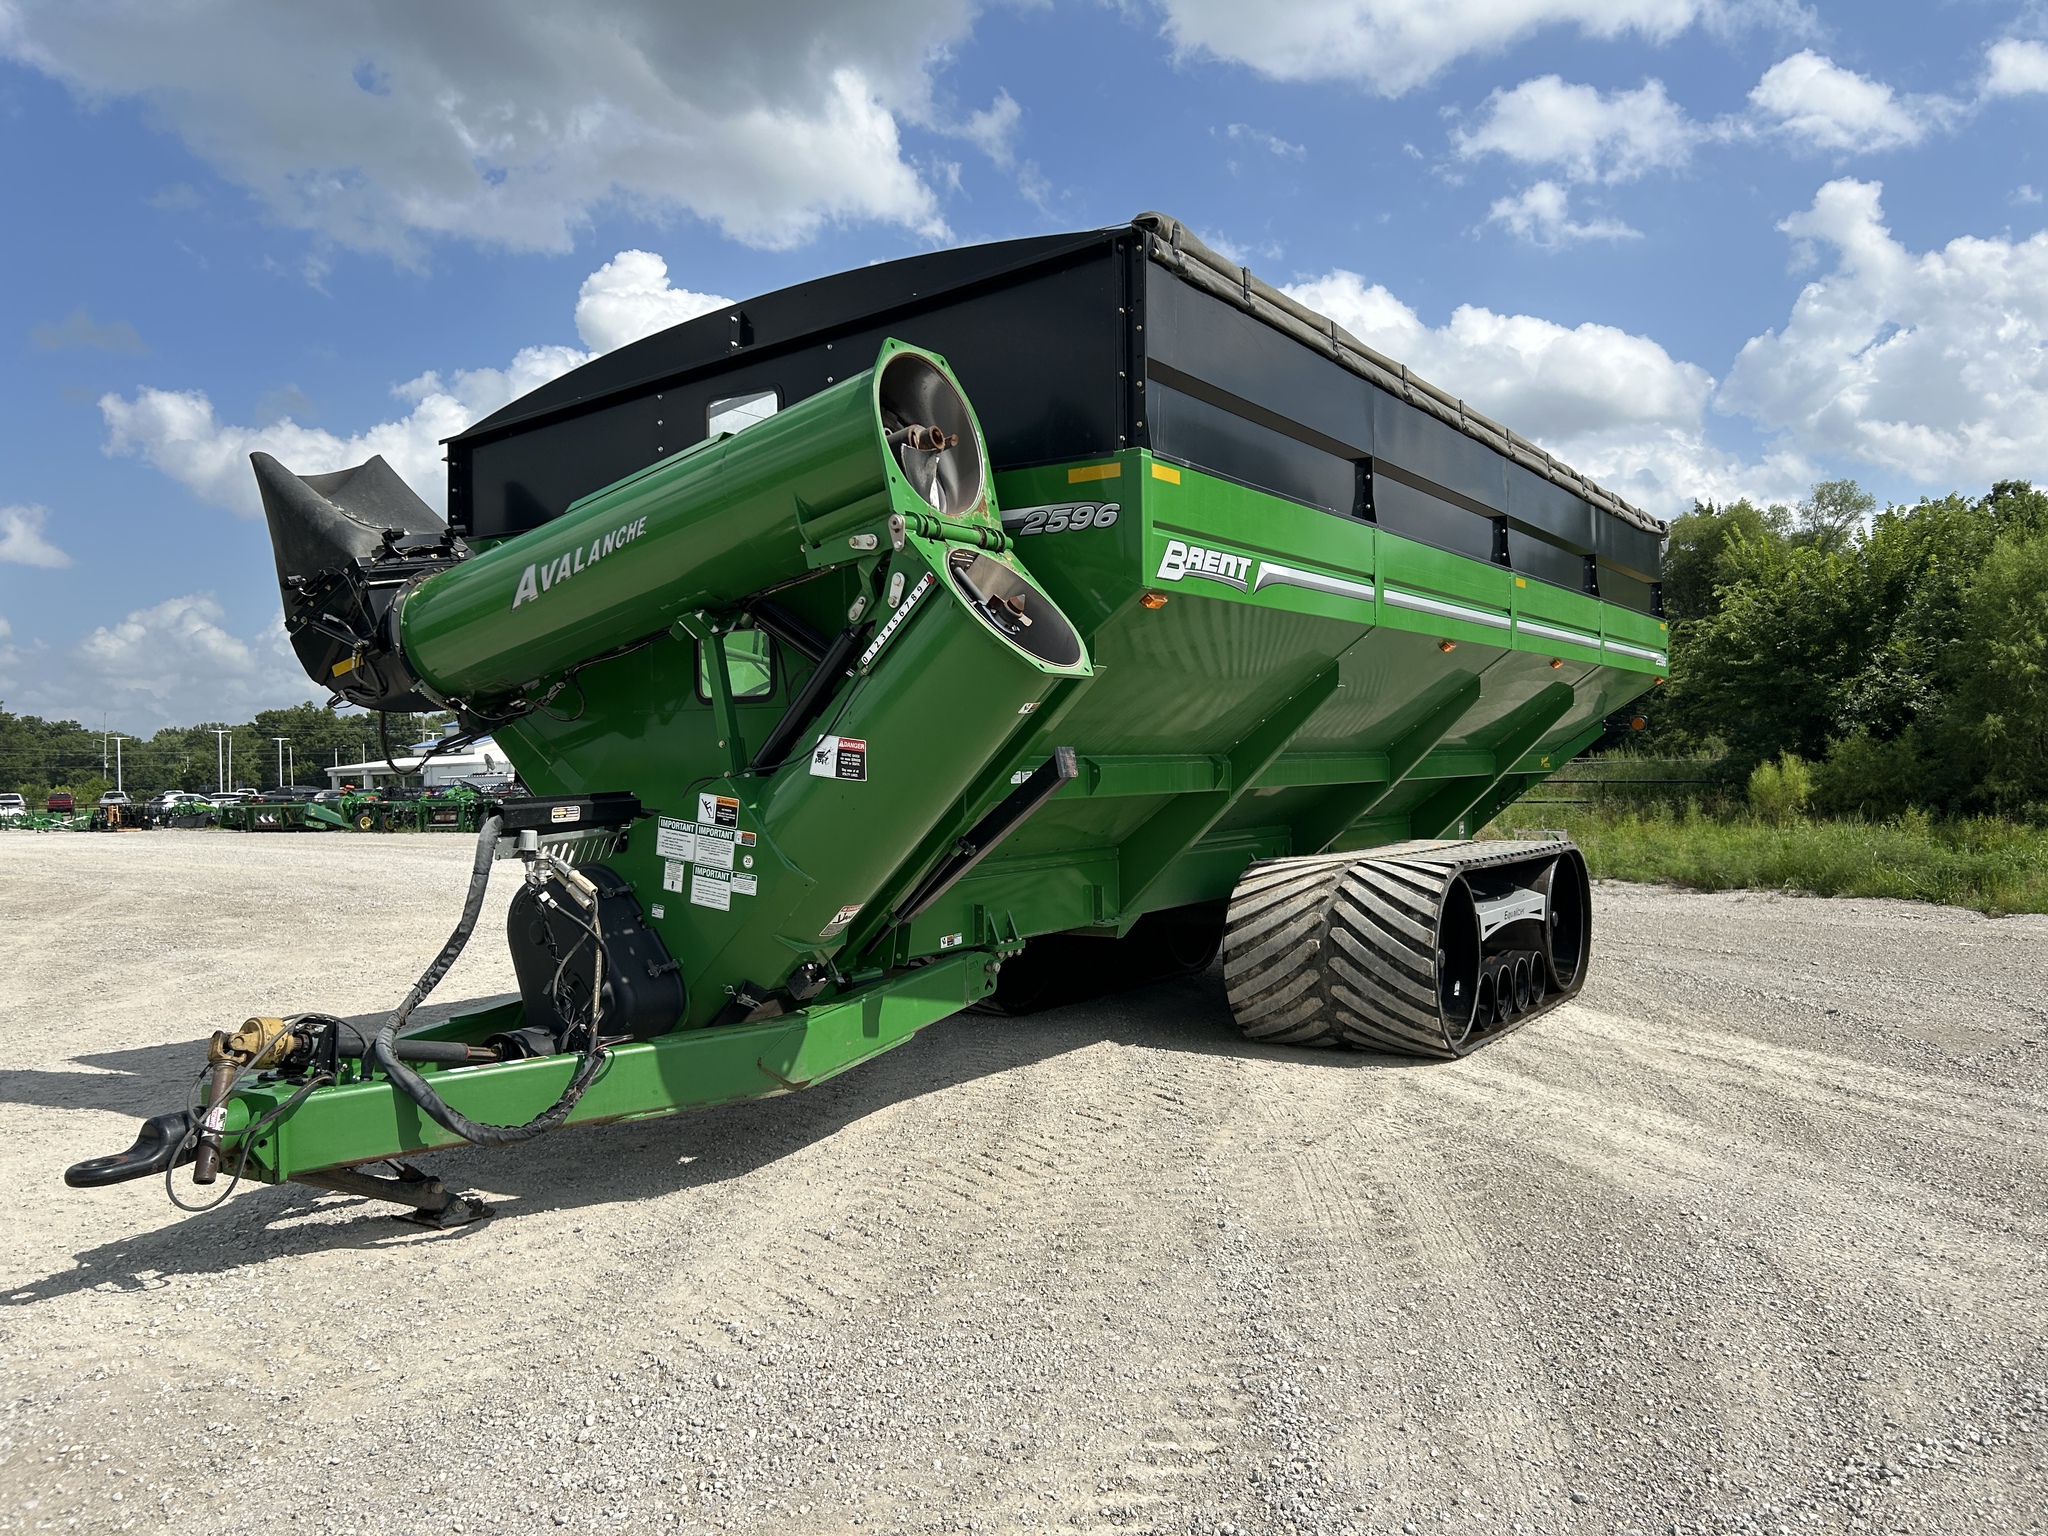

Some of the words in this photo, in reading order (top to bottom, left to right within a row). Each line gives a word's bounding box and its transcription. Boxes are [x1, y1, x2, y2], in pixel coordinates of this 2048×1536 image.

[1019, 503, 1121, 536] 2596
[510, 515, 648, 613] AVALANCHE
[1156, 540, 1253, 583] BRENT
[880, 633, 886, 641] 3
[844, 741, 865, 750] DANGER
[660, 819, 695, 833] IMPORTANT
[698, 825, 734, 840] IMPORTANT
[694, 866, 730, 881] IMPORTANT
